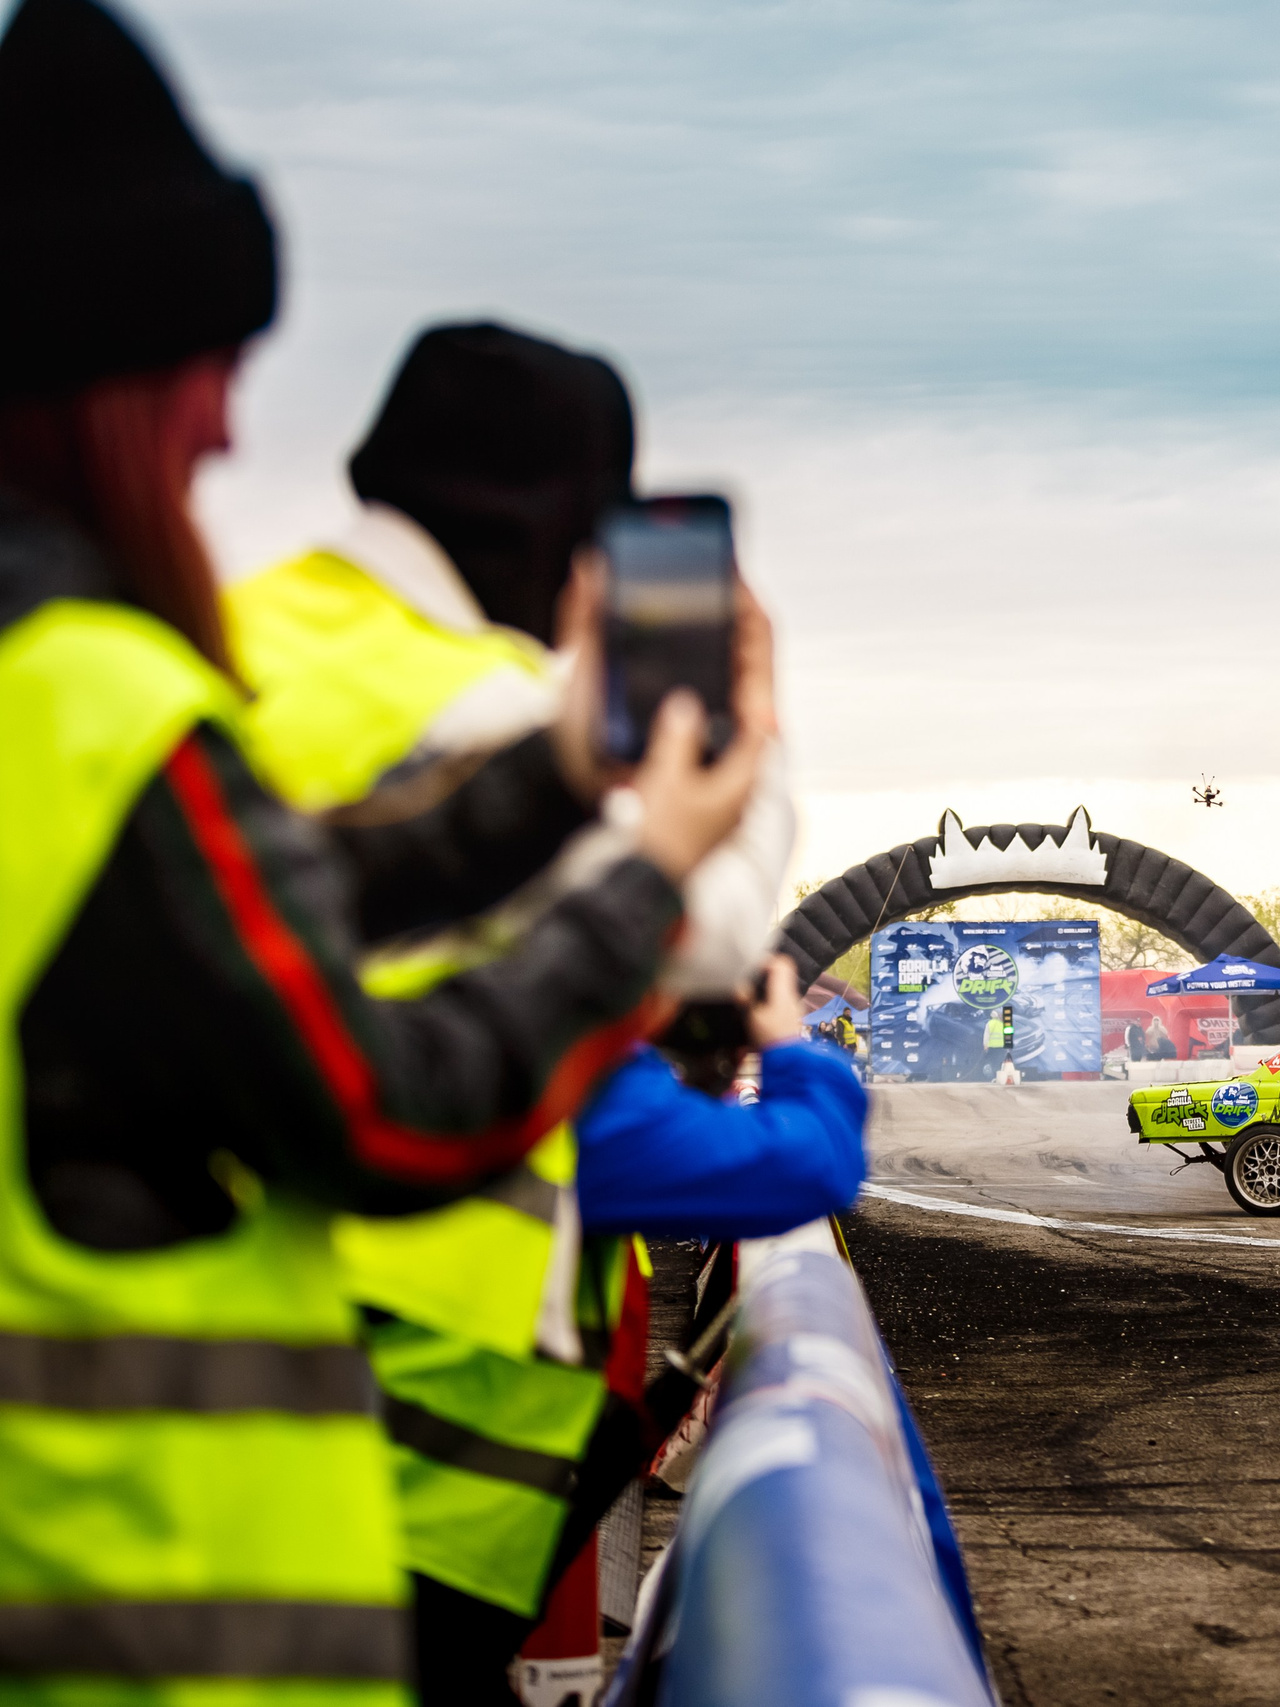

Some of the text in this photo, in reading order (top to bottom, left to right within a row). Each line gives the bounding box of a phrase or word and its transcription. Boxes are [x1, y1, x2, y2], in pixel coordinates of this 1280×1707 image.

[898, 959, 949, 973] GORILLA
[898, 972, 933, 985] DRIFT
[1186, 979, 1256, 989] POWER YOUR INSTINCT
[959, 979, 1014, 995] DRIFT
[1167, 1096, 1193, 1107] GORILLA
[1215, 1103, 1253, 1117] DRIFT
[1184, 1118, 1202, 1127] STREET
[1189, 1122, 1204, 1130] LEGAL
